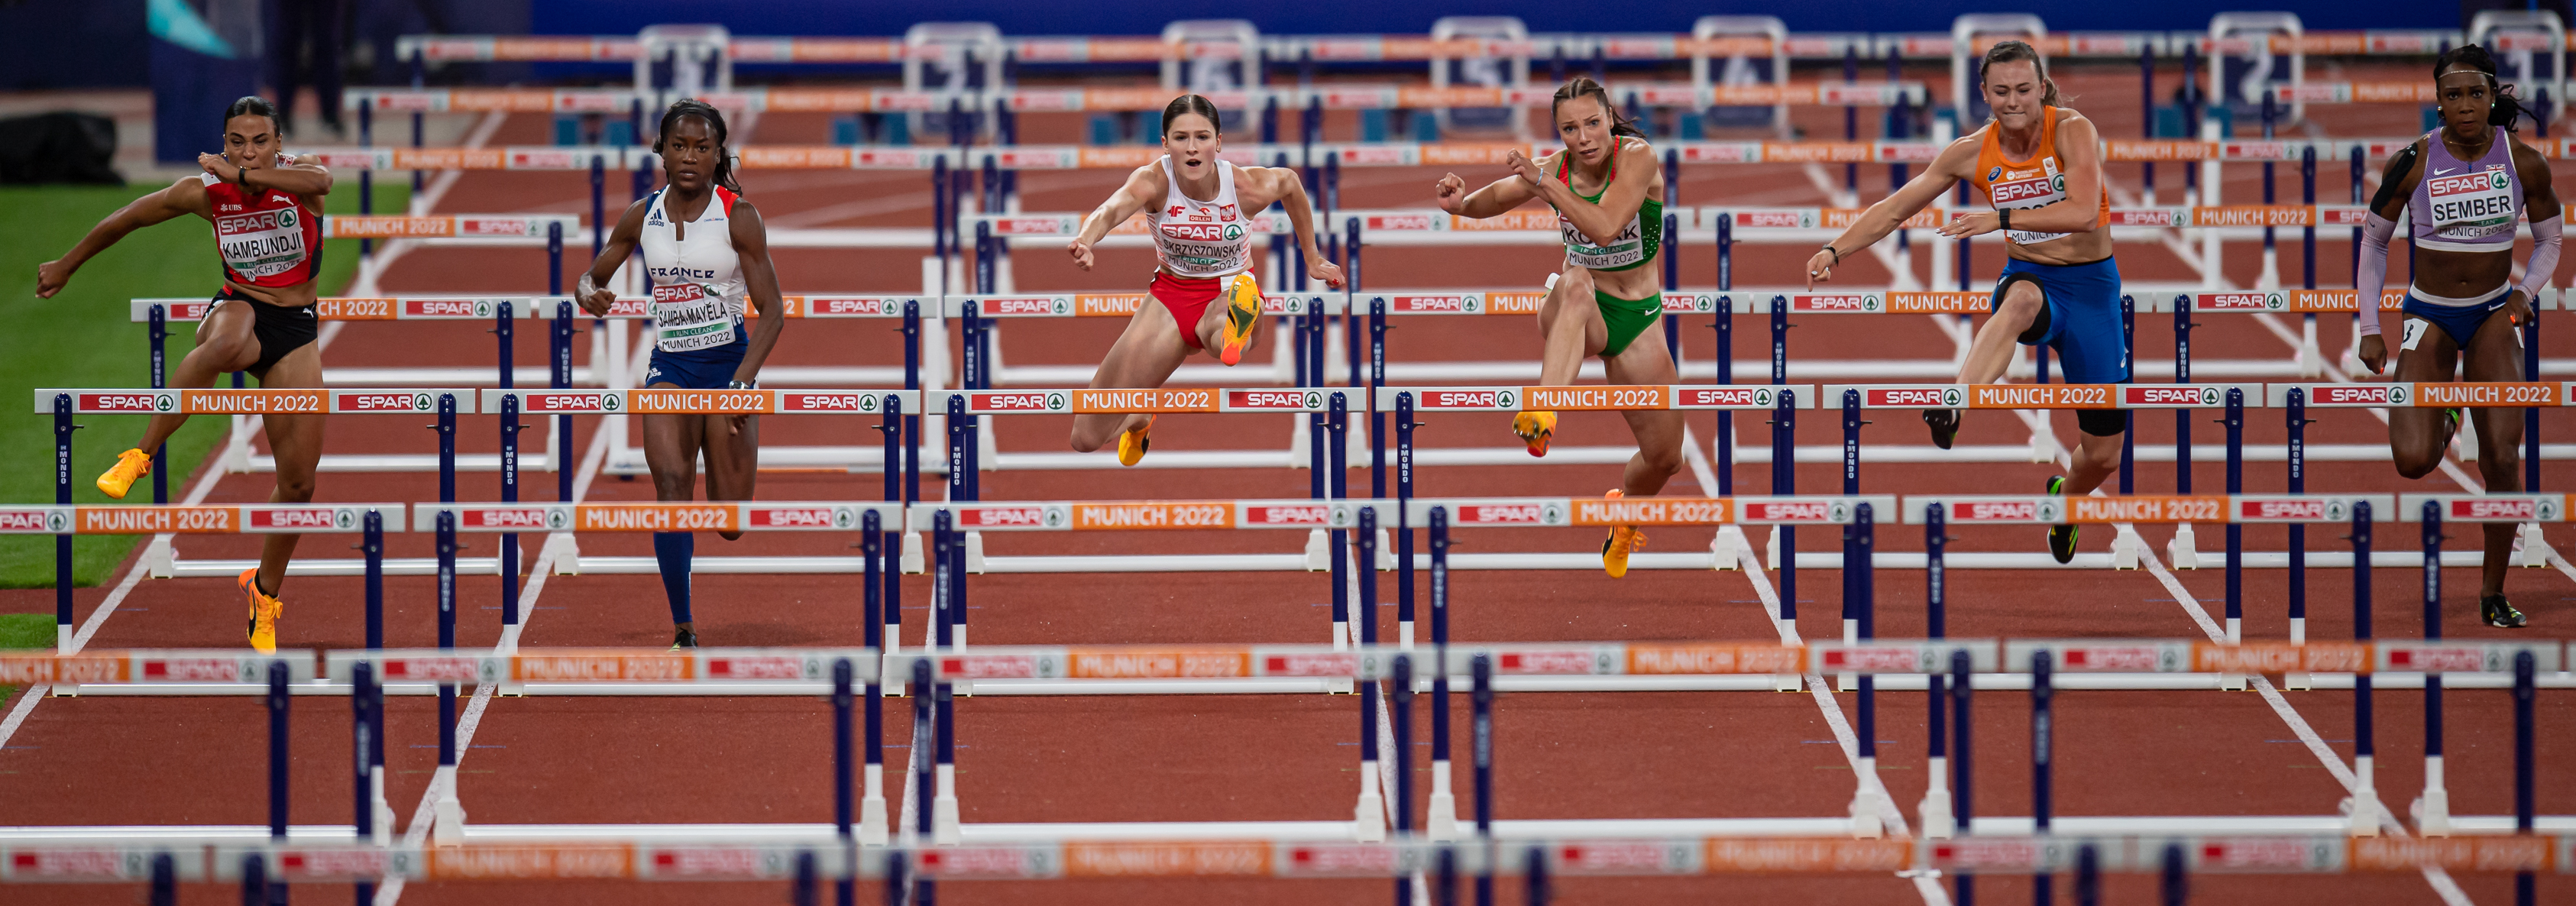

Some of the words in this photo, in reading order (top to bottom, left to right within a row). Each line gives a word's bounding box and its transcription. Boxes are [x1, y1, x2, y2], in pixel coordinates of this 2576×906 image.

[1996, 181, 2051, 200] SPAR
[2431, 176, 2489, 195] SPAR
[2434, 196, 2512, 222] SEMBER
[221, 215, 276, 233] SPAR
[1528, 215, 1559, 229] 202
[1752, 215, 1798, 227] SPAR
[2124, 212, 2169, 224] SPAR
[2202, 211, 2264, 225] MUNICH
[2270, 211, 2307, 225] 2022
[2339, 212, 2367, 223] SPA
[341, 220, 403, 234] MUNICH
[409, 220, 446, 234] 2022
[478, 221, 525, 234] SPAR
[1163, 226, 1222, 240] SPAR
[2438, 228, 2481, 237] MUNICH
[222, 232, 302, 260] KAMBUNDJI
[1168, 256, 1209, 272] MUNICH
[1213, 257, 1238, 271] 2022
[1569, 252, 1609, 265] MUNICH
[1613, 251, 1639, 264] 2022
[650, 267, 715, 279] FRANCE
[654, 285, 702, 302] SPAR
[347, 301, 387, 315] 2022
[422, 303, 472, 313] SPAR
[612, 300, 645, 312] PAR
[830, 302, 879, 312] SPAR
[1000, 301, 1050, 312] SPAR
[1410, 299, 1461, 310] SPAR
[1495, 296, 1539, 311] MUNI
[1662, 297, 1694, 309] PAR
[1811, 297, 1860, 308] SPAR
[1896, 295, 1962, 309] MUNICH
[1969, 296, 1991, 309] 20
[2215, 296, 2265, 307] SPAR
[662, 337, 701, 350] MUNICH
[704, 332, 731, 345] 2022
[639, 394, 711, 409] MUNICH
[719, 394, 764, 409] 2022
[990, 396, 1044, 407] SPAR
[1083, 393, 1157, 408] MUNICH
[1164, 392, 1209, 408] 2022
[1248, 394, 1302, 406] SPAR
[1441, 393, 1494, 405] SPAR
[1533, 391, 1606, 406] MUNICH
[1613, 390, 1659, 406] 2022
[1697, 391, 1751, 403] SPAR
[1886, 390, 1940, 403] SPAR
[1979, 389, 2053, 404] MUNICH
[2060, 388, 2105, 404] 2022
[2144, 390, 2199, 402] SPAR
[2332, 389, 2386, 401] SPAR
[2425, 387, 2498, 403] MUNICH
[2506, 387, 2551, 403] 2022
[99, 396, 152, 408] SPAR
[193, 396, 265, 411] MUNICH
[273, 395, 318, 411] 2022
[358, 396, 411, 408] SPAR
[545, 396, 599, 408] SPAR
[802, 396, 857, 408] SPAR
[2292, 445, 2300, 477] MONDO
[953, 452, 961, 485] MONDO
[1083, 506, 1166, 524] MUNICH
[1173, 506, 1225, 524] 2022
[1266, 509, 1328, 522] SPAR
[1478, 507, 1540, 520] SPAR
[1581, 503, 1664, 521] MUNICH
[1671, 503, 1723, 521] 2022
[1766, 506, 1828, 519] SPAR
[1972, 504, 2035, 517] SPAR
[2076, 501, 2160, 519] MUNICH
[2167, 501, 2219, 519] 2022
[2262, 503, 2323, 516] SPAR
[2473, 503, 2535, 516] SPAR
[0, 513, 44, 527] PAR
[87, 511, 169, 529] MUNICH
[178, 511, 228, 529] 2022
[272, 513, 332, 526] SPAR
[483, 512, 544, 525] SPAR
[587, 510, 668, 527] MUNICH
[676, 510, 727, 527] 2022
[769, 511, 831, 524] SPAR
[979, 510, 1041, 523] SPAR
